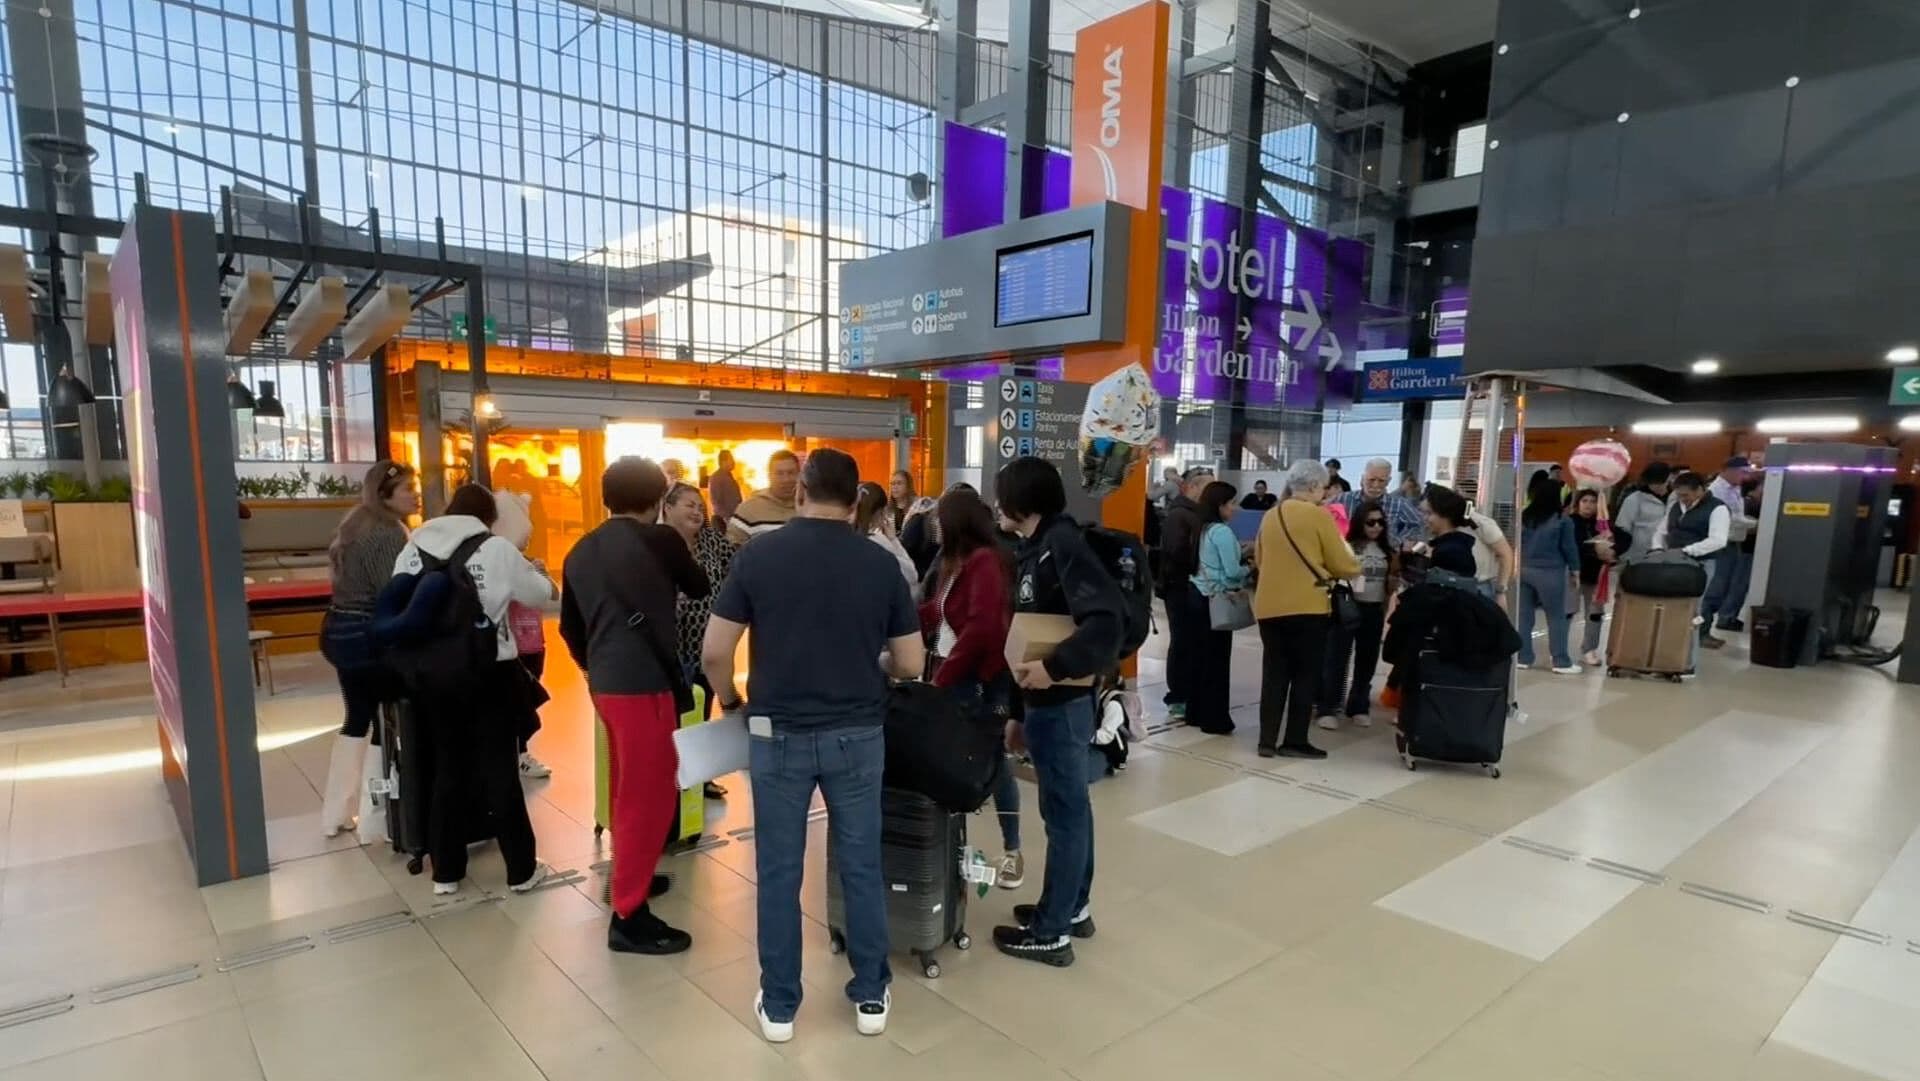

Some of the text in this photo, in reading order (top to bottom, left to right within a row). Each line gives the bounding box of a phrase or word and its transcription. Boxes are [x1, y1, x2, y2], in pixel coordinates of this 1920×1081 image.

[1101, 45, 1124, 148] OMA
[1391, 367, 1426, 378] Hilton
[1037, 382, 1055, 394] Taxis
[1390, 376, 1447, 390] Garden
[1034, 437, 1055, 449] Renta
[1056, 439, 1065, 450] de
